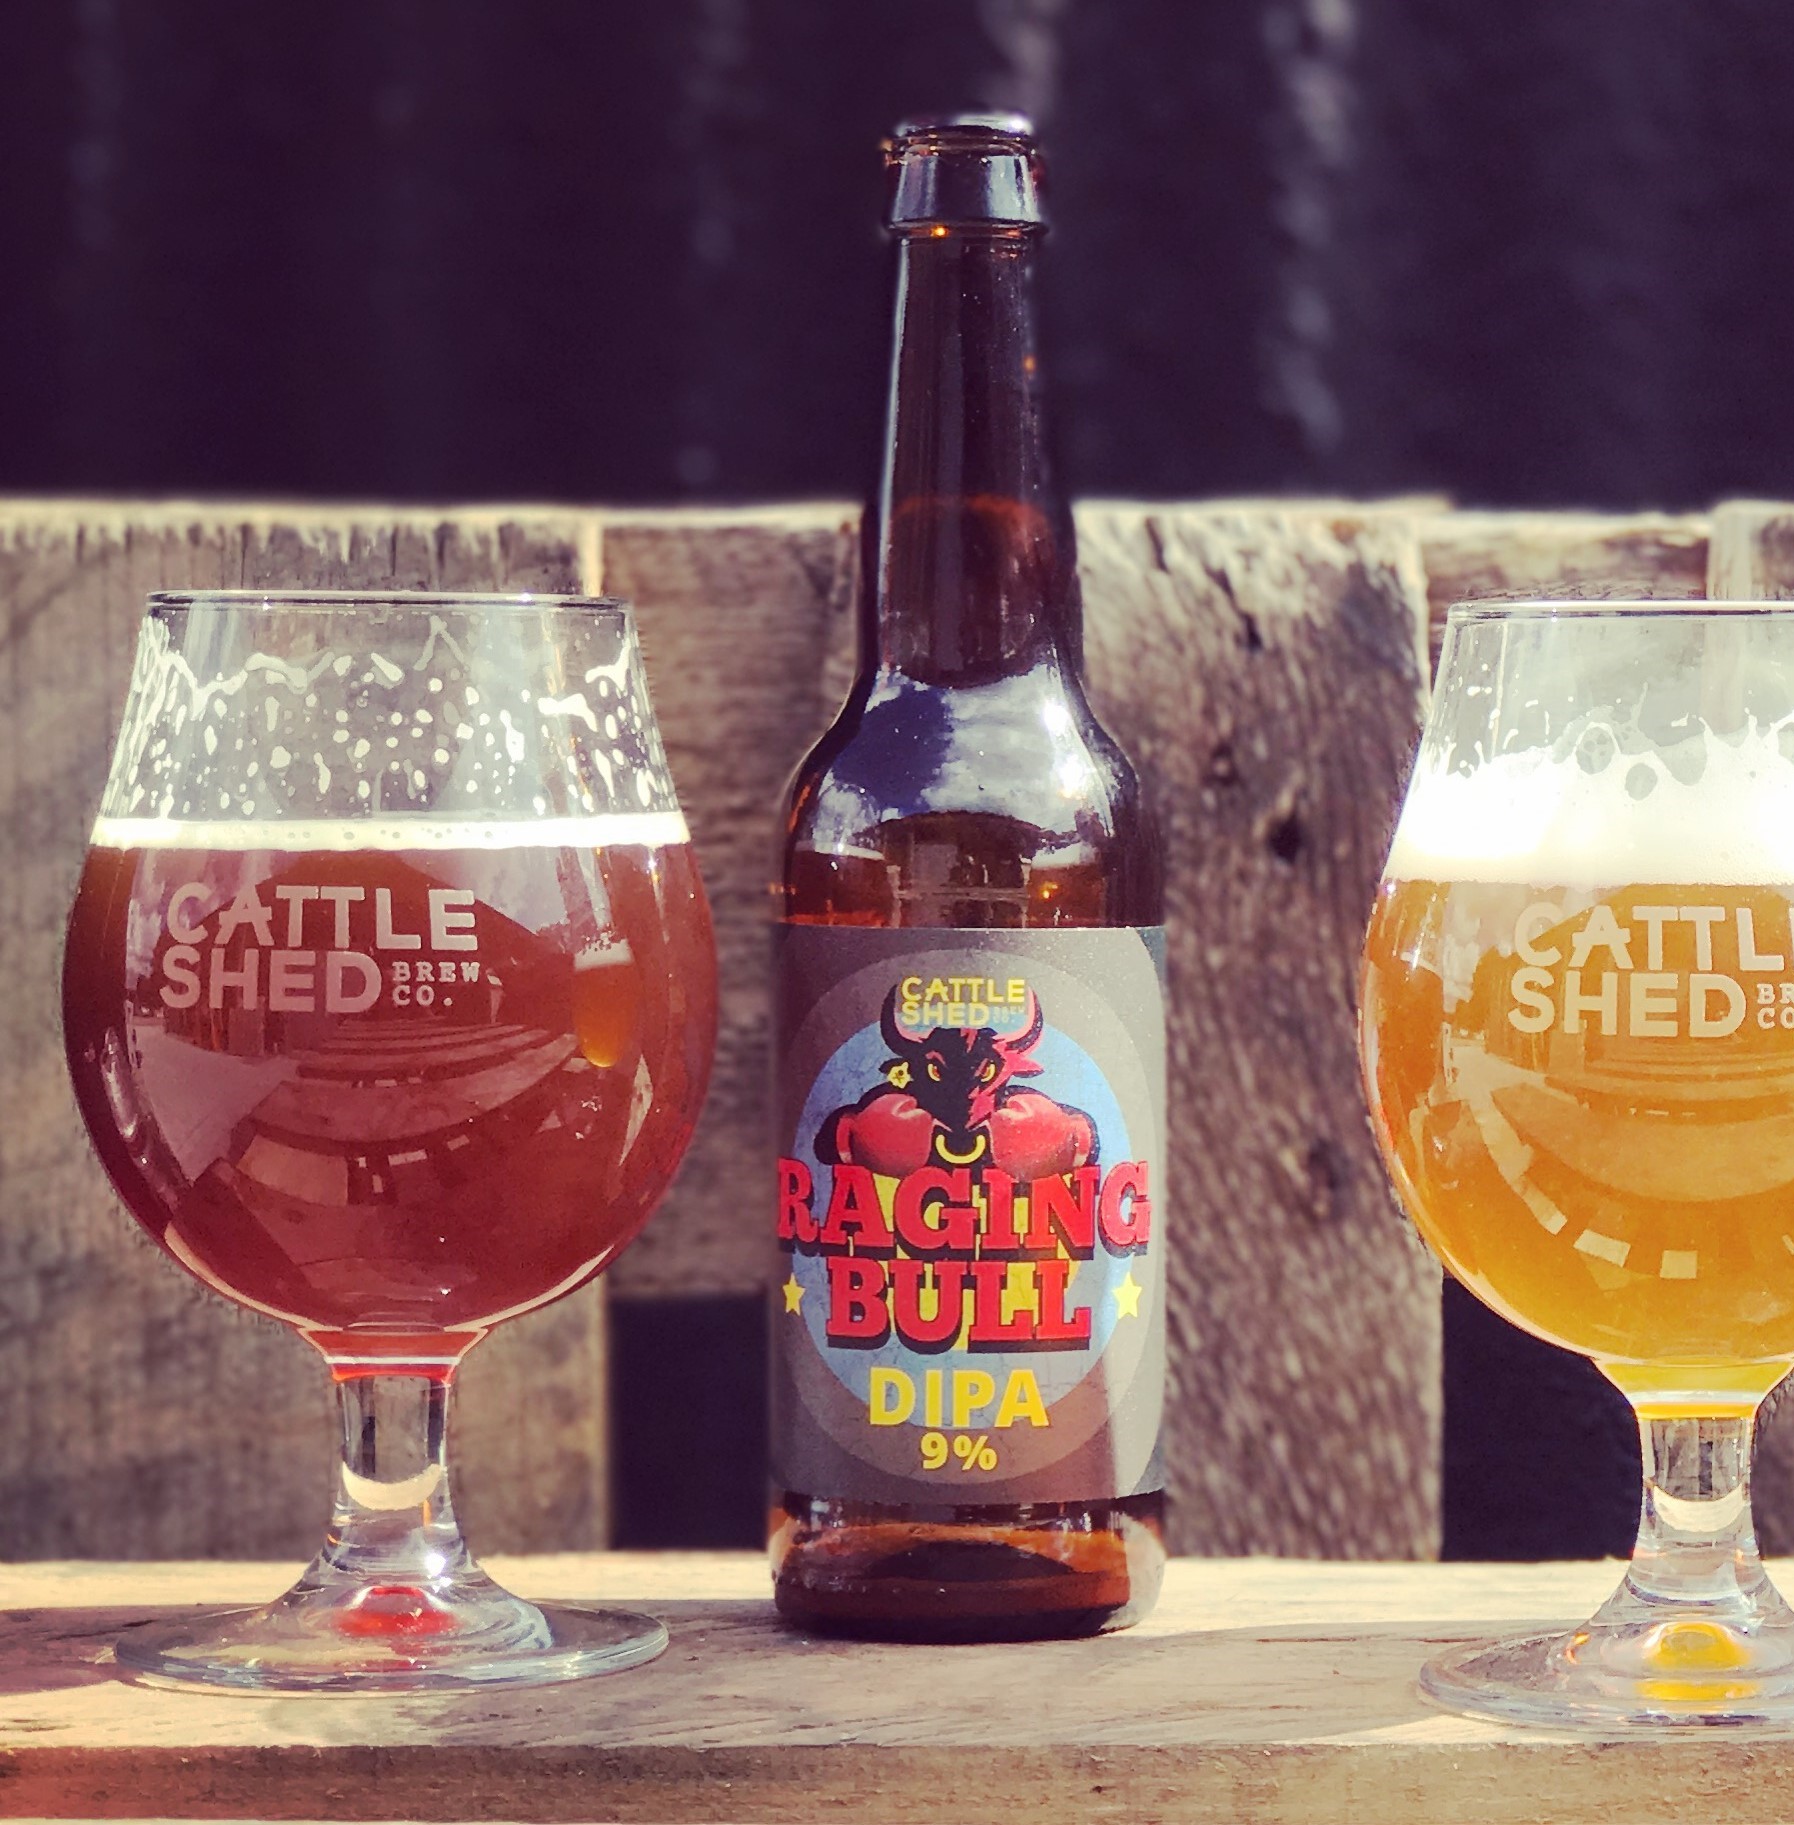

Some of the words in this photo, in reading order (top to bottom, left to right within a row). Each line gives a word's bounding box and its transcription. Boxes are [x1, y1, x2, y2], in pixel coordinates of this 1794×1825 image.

[167, 883, 478, 951] CATTLE
[159, 945, 382, 1013] SHED
[391, 961, 480, 982] BREW
[391, 985, 453, 1006] CO.
[901, 976, 1025, 1002] CATTLE
[1507, 968, 1746, 1037] SHED
[901, 1001, 989, 1026] SHED
[778, 1157, 1151, 1257] RAGING
[825, 1256, 1091, 1351] BULL
[869, 1367, 1049, 1428] DIPA
[920, 1432, 998, 1472] 9%
